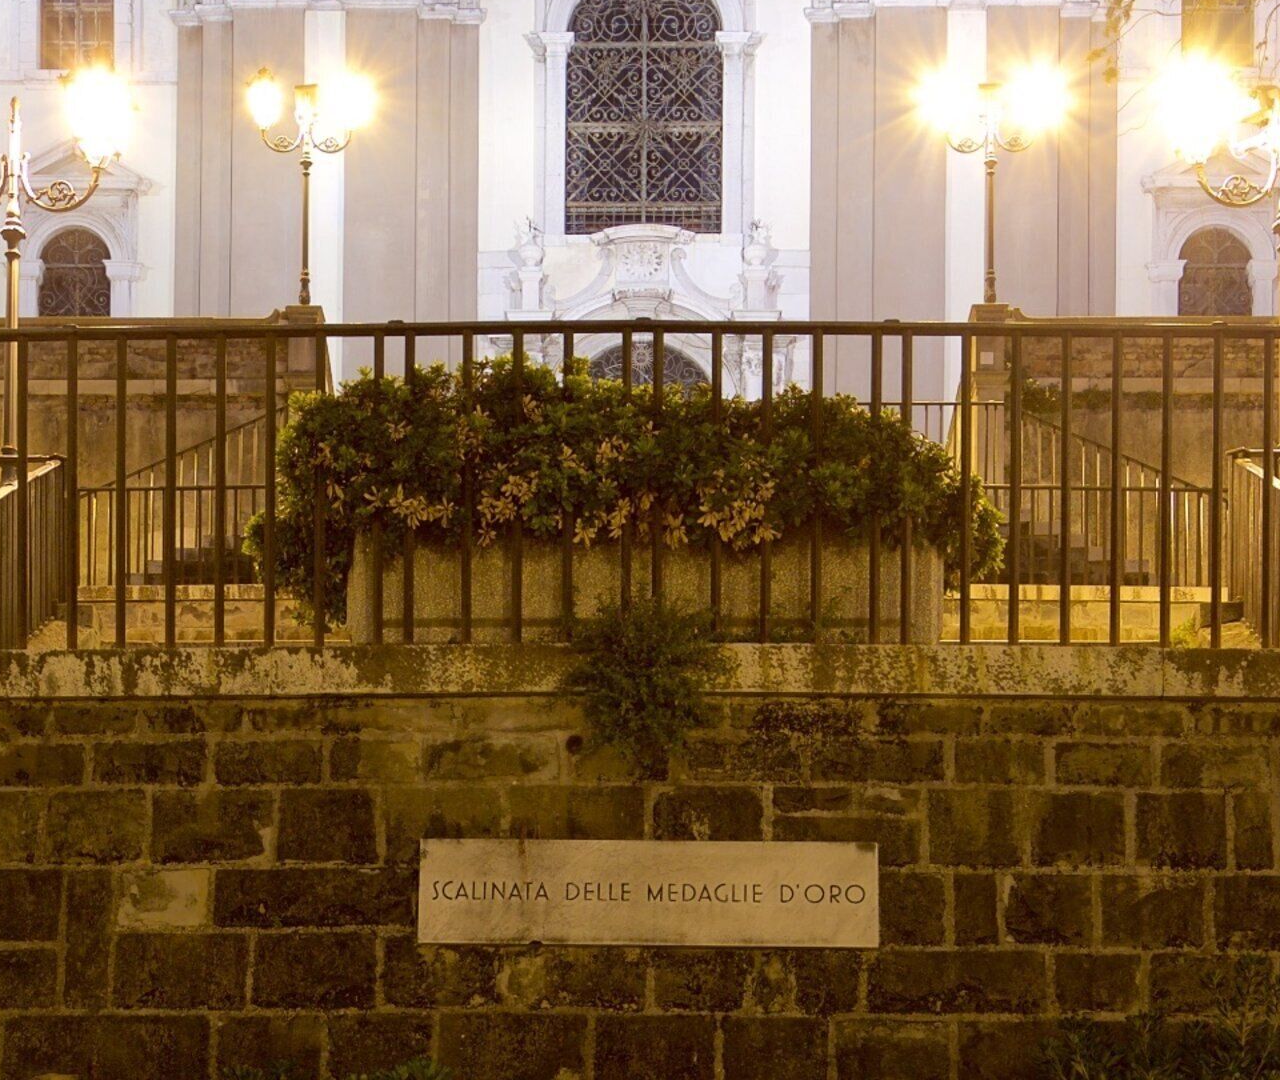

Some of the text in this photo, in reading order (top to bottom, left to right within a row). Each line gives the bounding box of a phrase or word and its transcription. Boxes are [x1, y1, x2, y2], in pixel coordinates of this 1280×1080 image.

[431, 879, 867, 905] SCALINATA DELLE MEDAGLIE D'ORO
